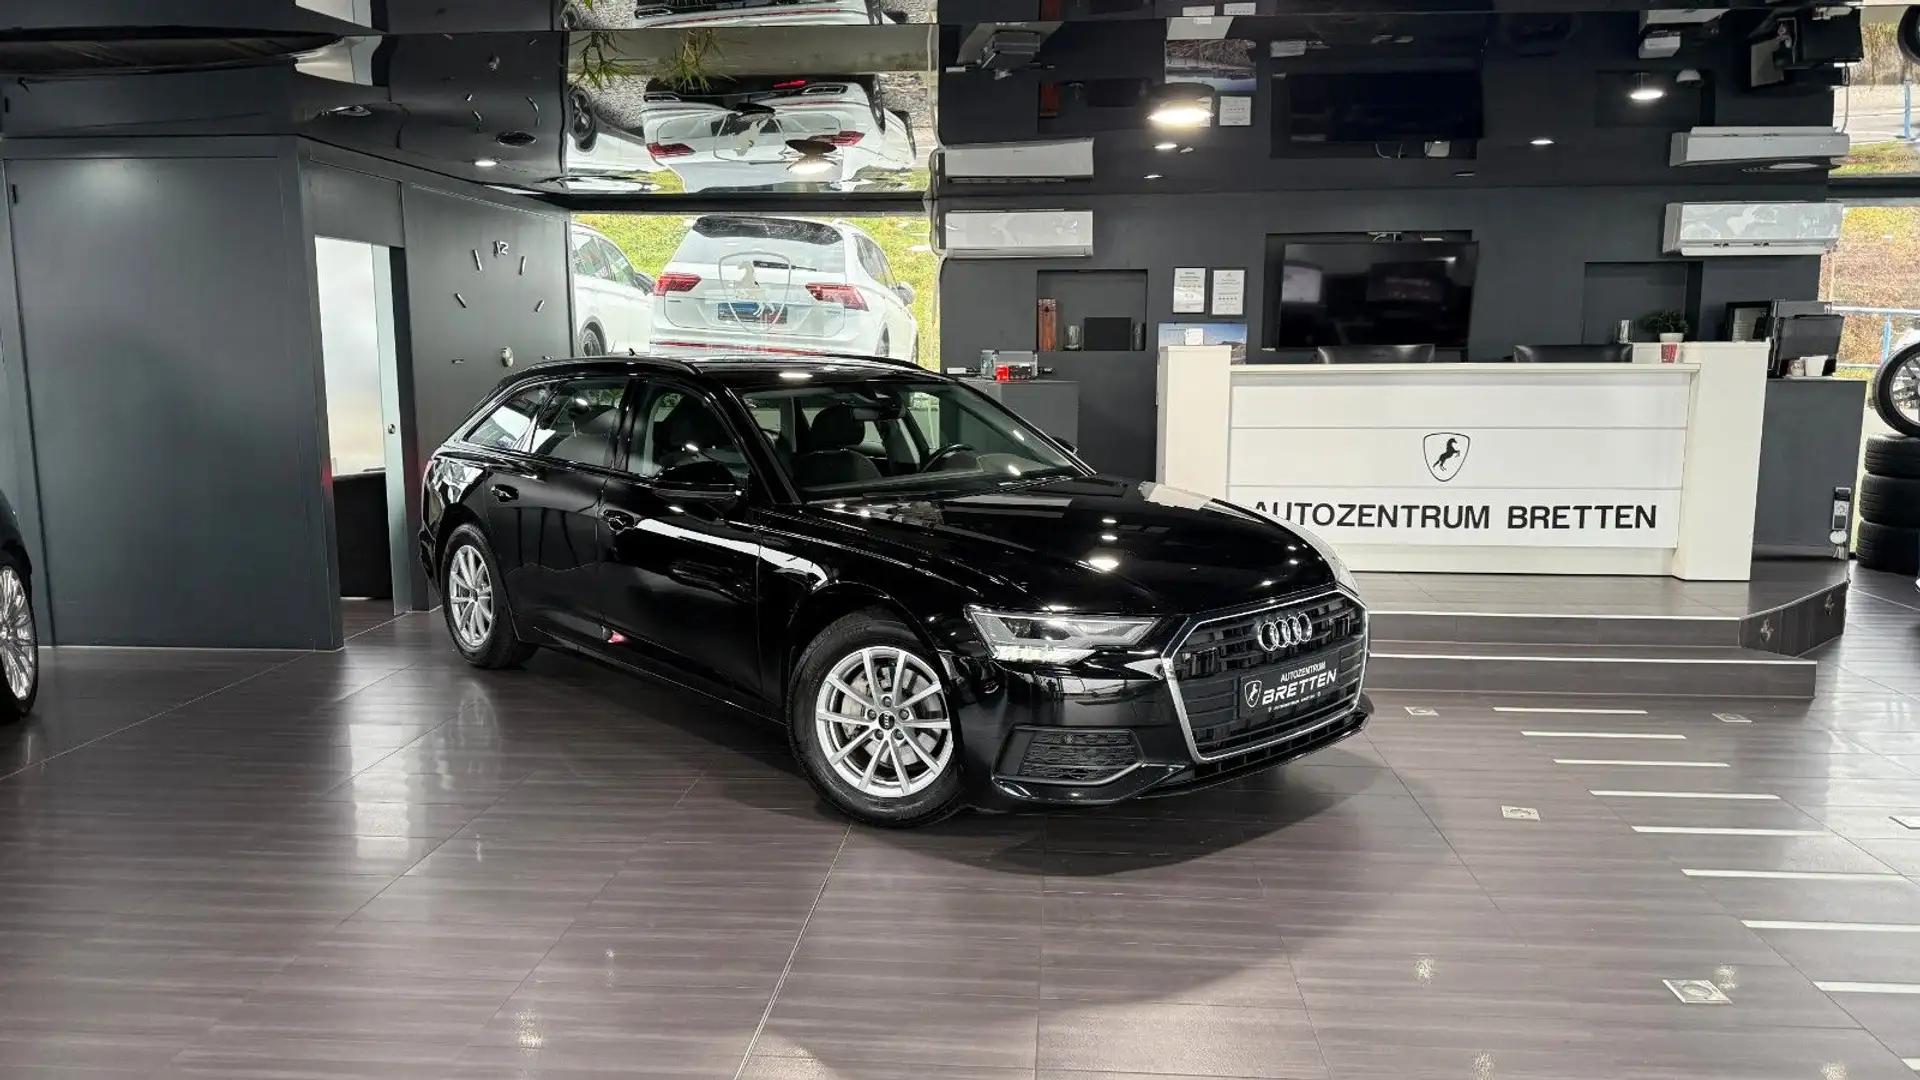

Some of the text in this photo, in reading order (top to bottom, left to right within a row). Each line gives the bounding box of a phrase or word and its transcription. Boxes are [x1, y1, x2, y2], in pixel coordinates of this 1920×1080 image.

[493, 240, 509, 257] 12
[1507, 504, 1658, 530] BRETTEN
[1280, 660, 1326, 682] AUTOZENTRUM
[1262, 668, 1337, 705] BRETTEN
